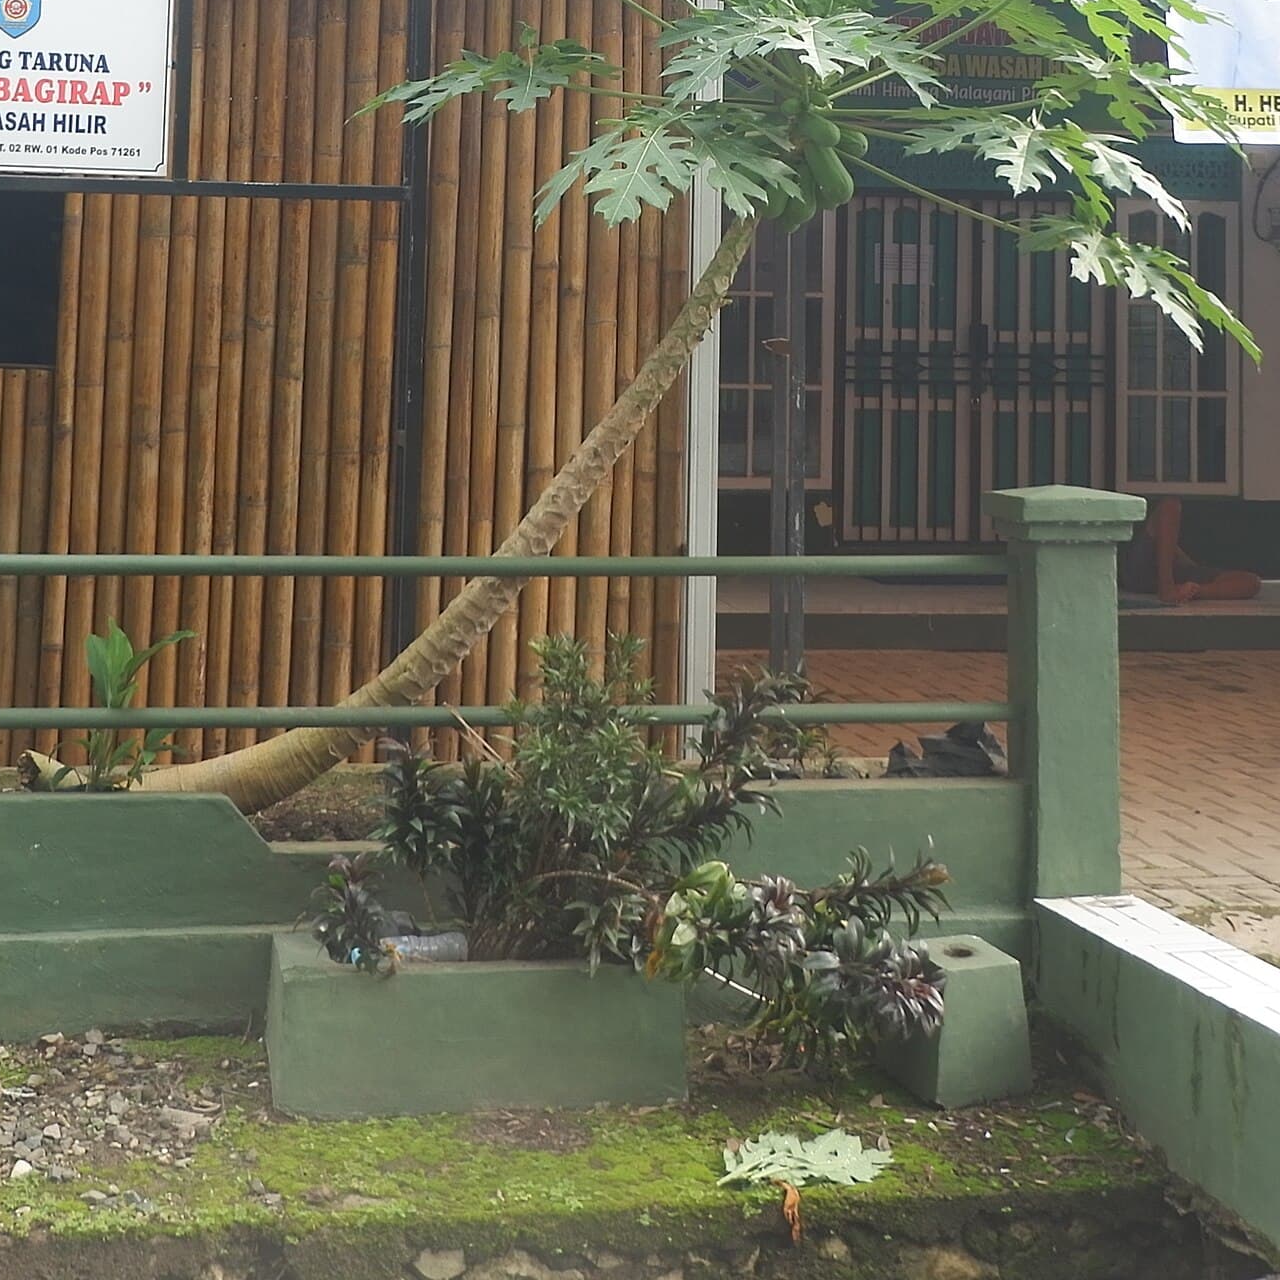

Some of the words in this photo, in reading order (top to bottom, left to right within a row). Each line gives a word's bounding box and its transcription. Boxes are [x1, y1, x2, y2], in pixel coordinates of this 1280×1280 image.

[18, 51, 111, 74] TARUNA
[967, 54, 1042, 79] WASAH
[1235, 94, 1252, 111] H.
[53, 113, 107, 135] HILIR
[8, 143, 22, 153] 02
[24, 144, 44, 154] RW.
[45, 144, 58, 155] 01
[61, 145, 87, 156] Kode
[89, 146, 108, 156] Pos
[111, 147, 141, 158] 71261
